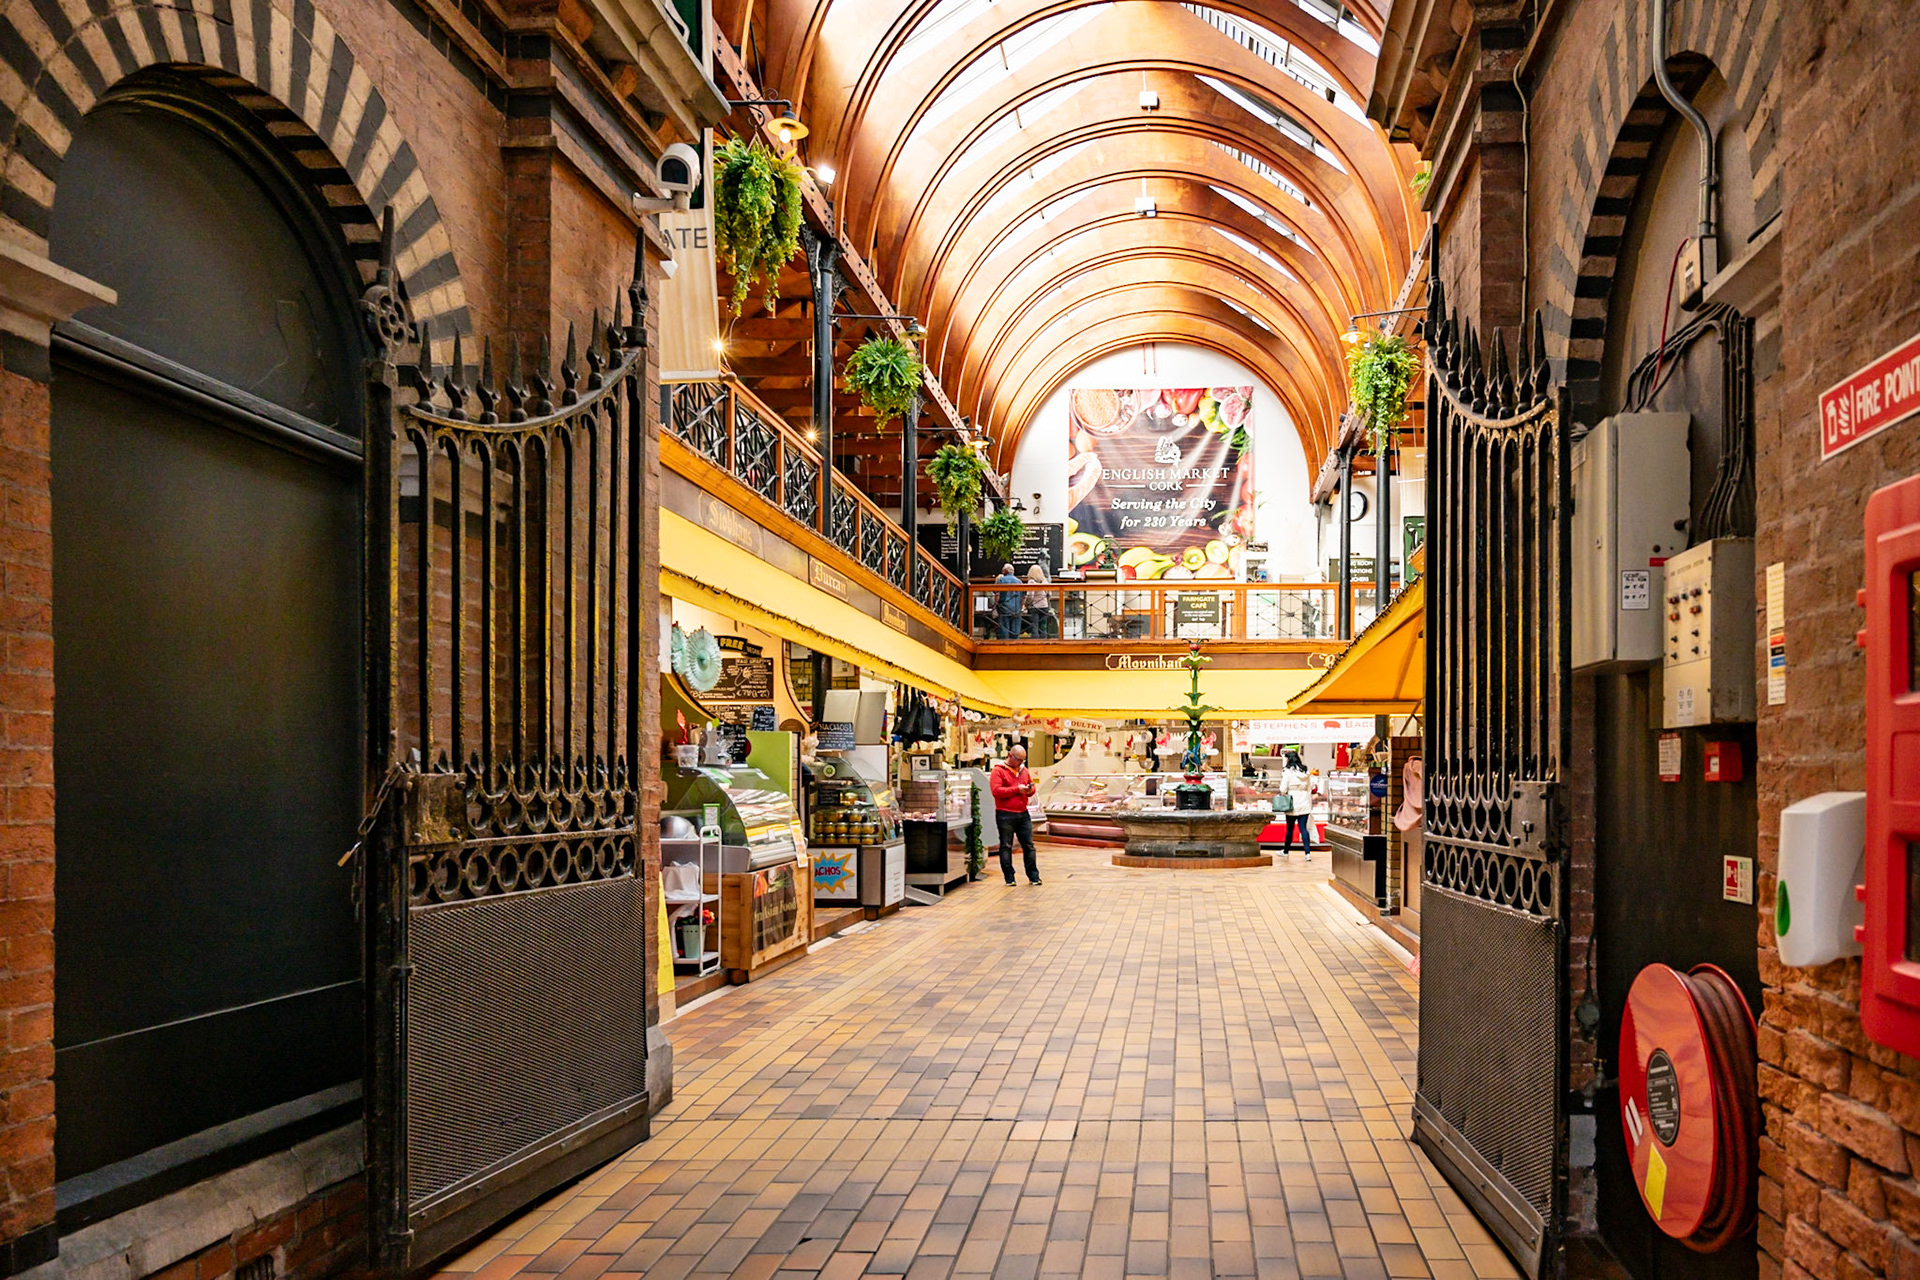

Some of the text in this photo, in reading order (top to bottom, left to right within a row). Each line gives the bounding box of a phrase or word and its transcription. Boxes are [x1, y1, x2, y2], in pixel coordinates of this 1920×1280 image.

[1856, 354, 1920, 424] FIRE POINT
[1102, 467, 1230, 481] ENGLISH MARKET
[1149, 481, 1184, 491] CORK
[1111, 497, 1217, 511] Serving the City
[1120, 515, 1207, 530] for 230 Years
[720, 637, 745, 651] FREE
[1070, 720, 1103, 730] OULTRY
